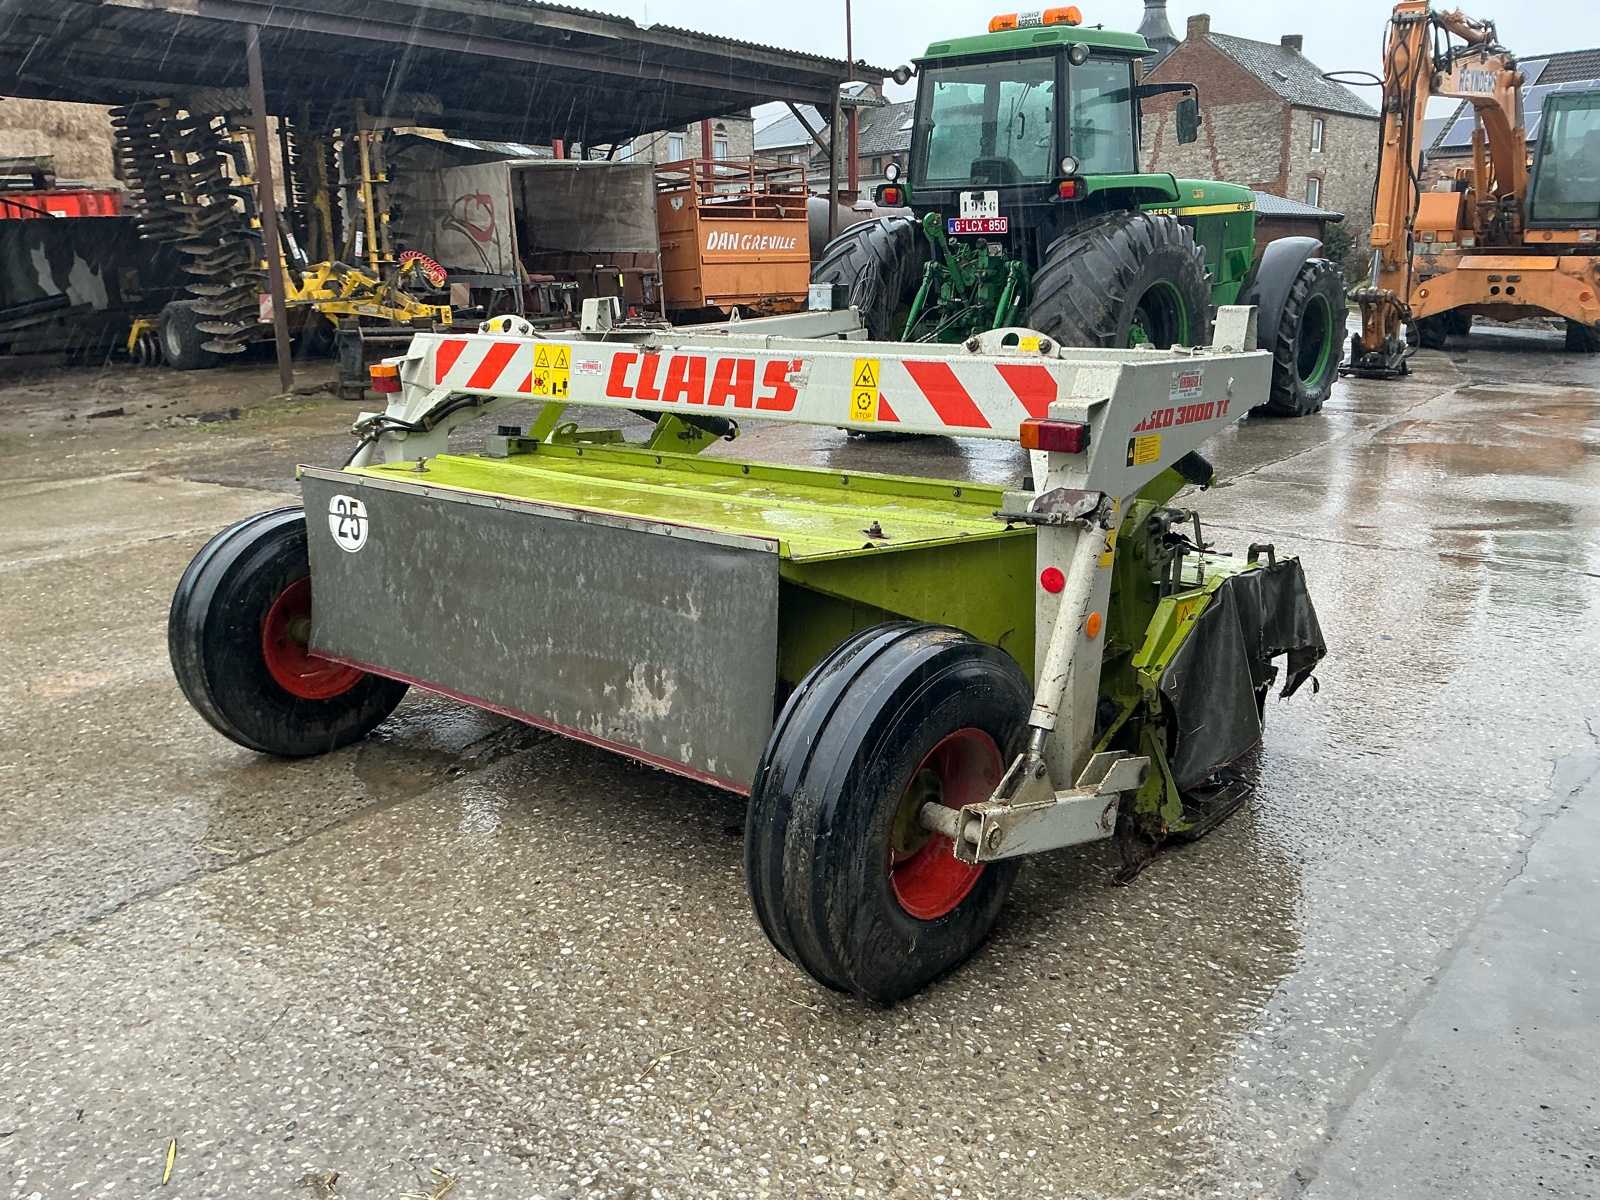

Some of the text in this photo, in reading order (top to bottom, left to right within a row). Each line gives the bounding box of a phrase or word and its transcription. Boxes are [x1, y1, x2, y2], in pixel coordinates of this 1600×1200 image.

[706, 231, 797, 250] DAN GREVILLE
[605, 351, 803, 412] CLAAS
[1176, 401, 1214, 425] 3000
[337, 499, 360, 540] 25
